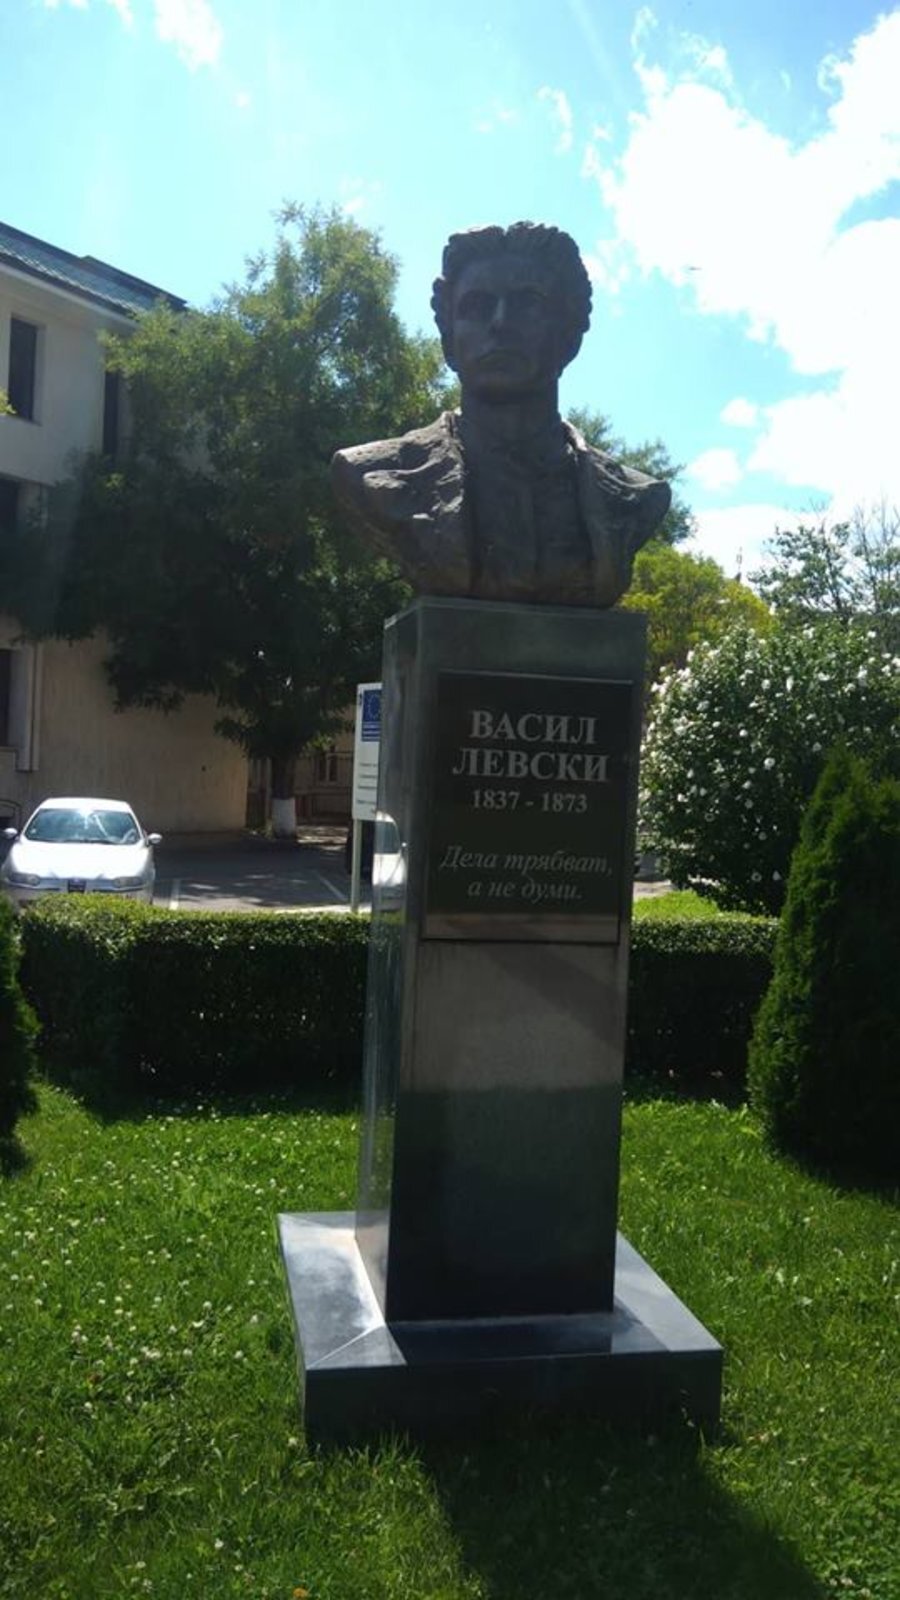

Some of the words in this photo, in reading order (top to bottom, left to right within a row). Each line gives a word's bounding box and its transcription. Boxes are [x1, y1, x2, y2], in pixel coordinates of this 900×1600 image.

[469, 709, 598, 745] ВАСИЛ
[452, 747, 609, 783] ЛЕВСКИ
[472, 789, 520, 811] 1837
[542, 792, 588, 813] 1873
[440, 845, 497, 870] Дела
[504, 850, 613, 876] трябват,
[467, 881, 481, 896] а
[488, 881, 516, 898] не
[521, 878, 583, 904] думи.
